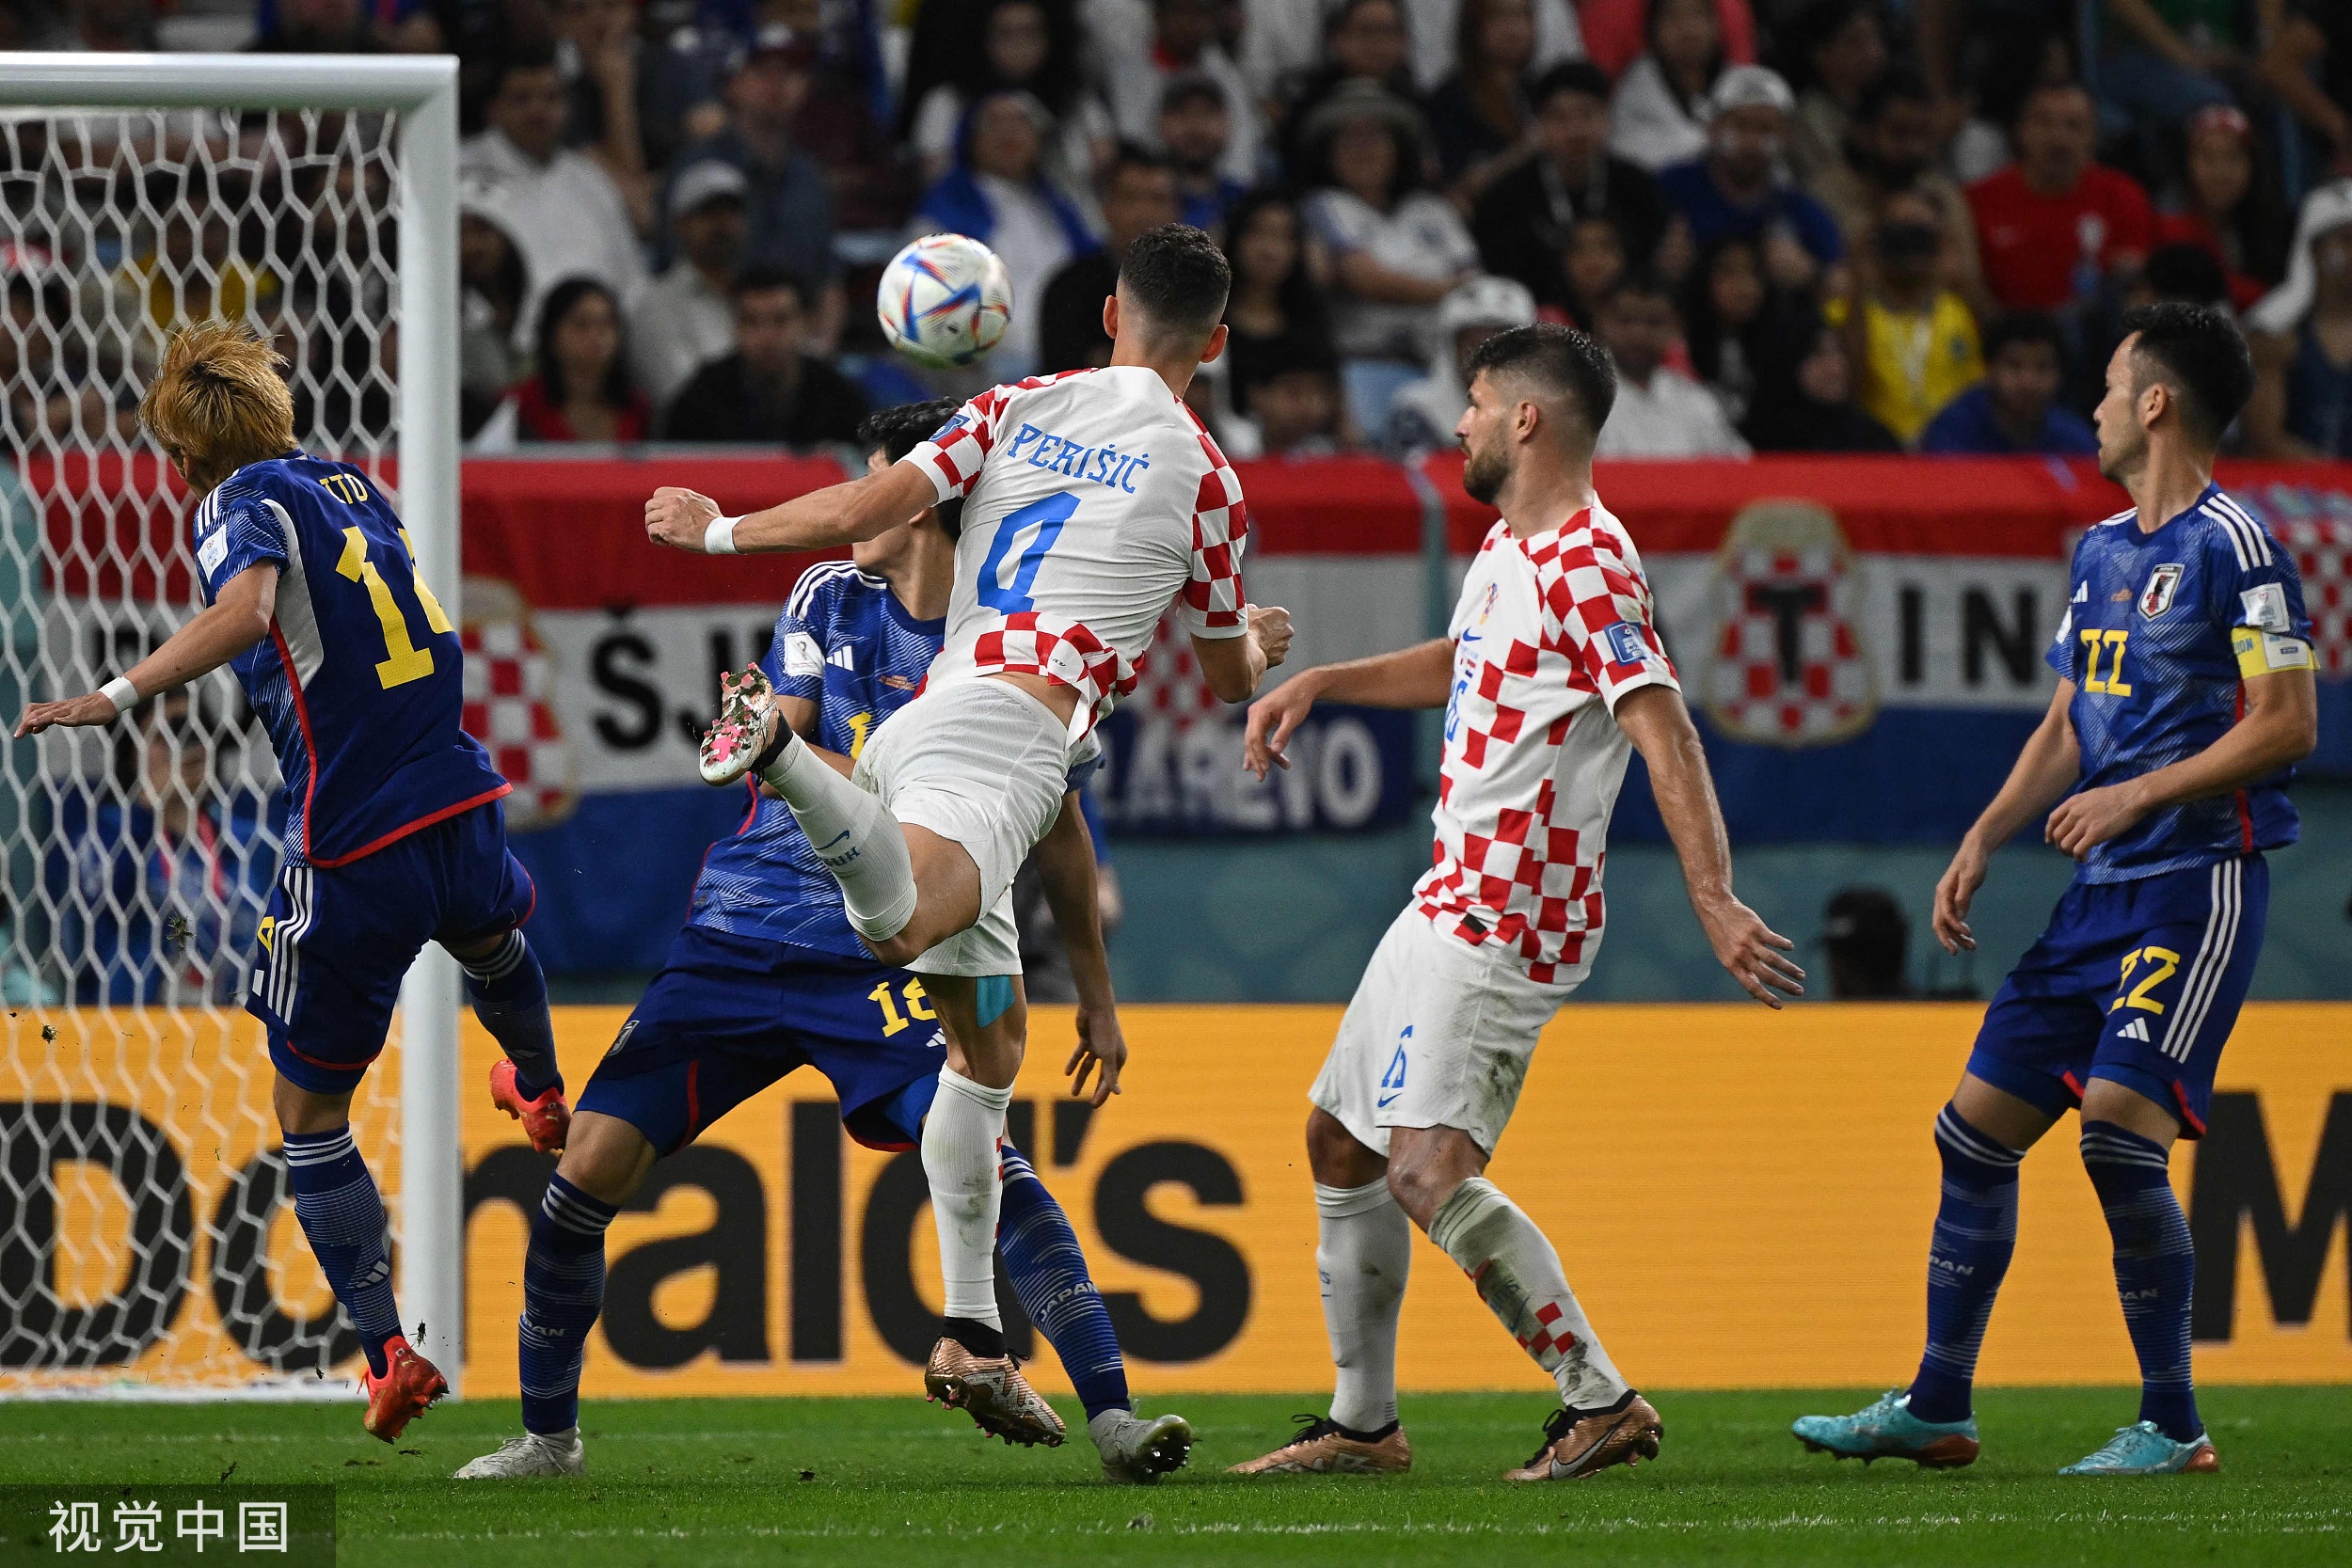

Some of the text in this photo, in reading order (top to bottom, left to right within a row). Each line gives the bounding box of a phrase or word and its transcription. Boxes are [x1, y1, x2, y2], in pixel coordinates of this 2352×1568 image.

[1007, 422, 1150, 495] PERIŠIĆ
[2080, 628, 2133, 697] 22
[2106, 945, 2181, 1016] 22
[1041, 1280, 1100, 1323] JAPAN
